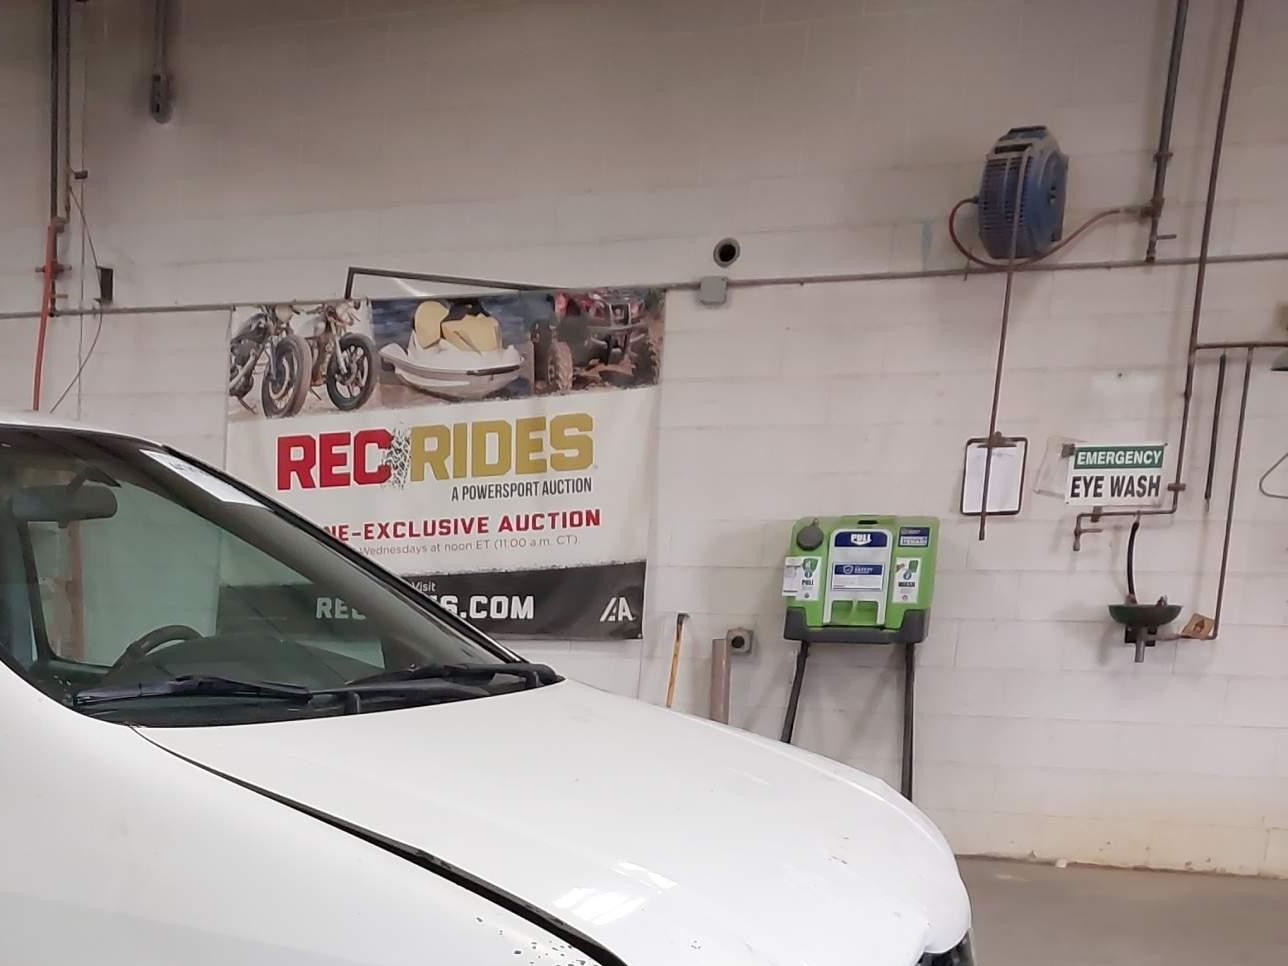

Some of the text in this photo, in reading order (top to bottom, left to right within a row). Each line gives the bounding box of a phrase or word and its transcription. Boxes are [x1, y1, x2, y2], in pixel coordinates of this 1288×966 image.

[276, 413, 594, 491] REC RIDES
[1076, 450, 1163, 465] EMERGENCY
[451, 477, 592, 501] A POWERSPORT AUCTION
[1070, 474, 1161, 498] EYE WASH
[498, 509, 601, 532] AUCTION
[430, 543, 441, 553] at
[444, 541, 473, 552] noon
[476, 539, 490, 550] ET
